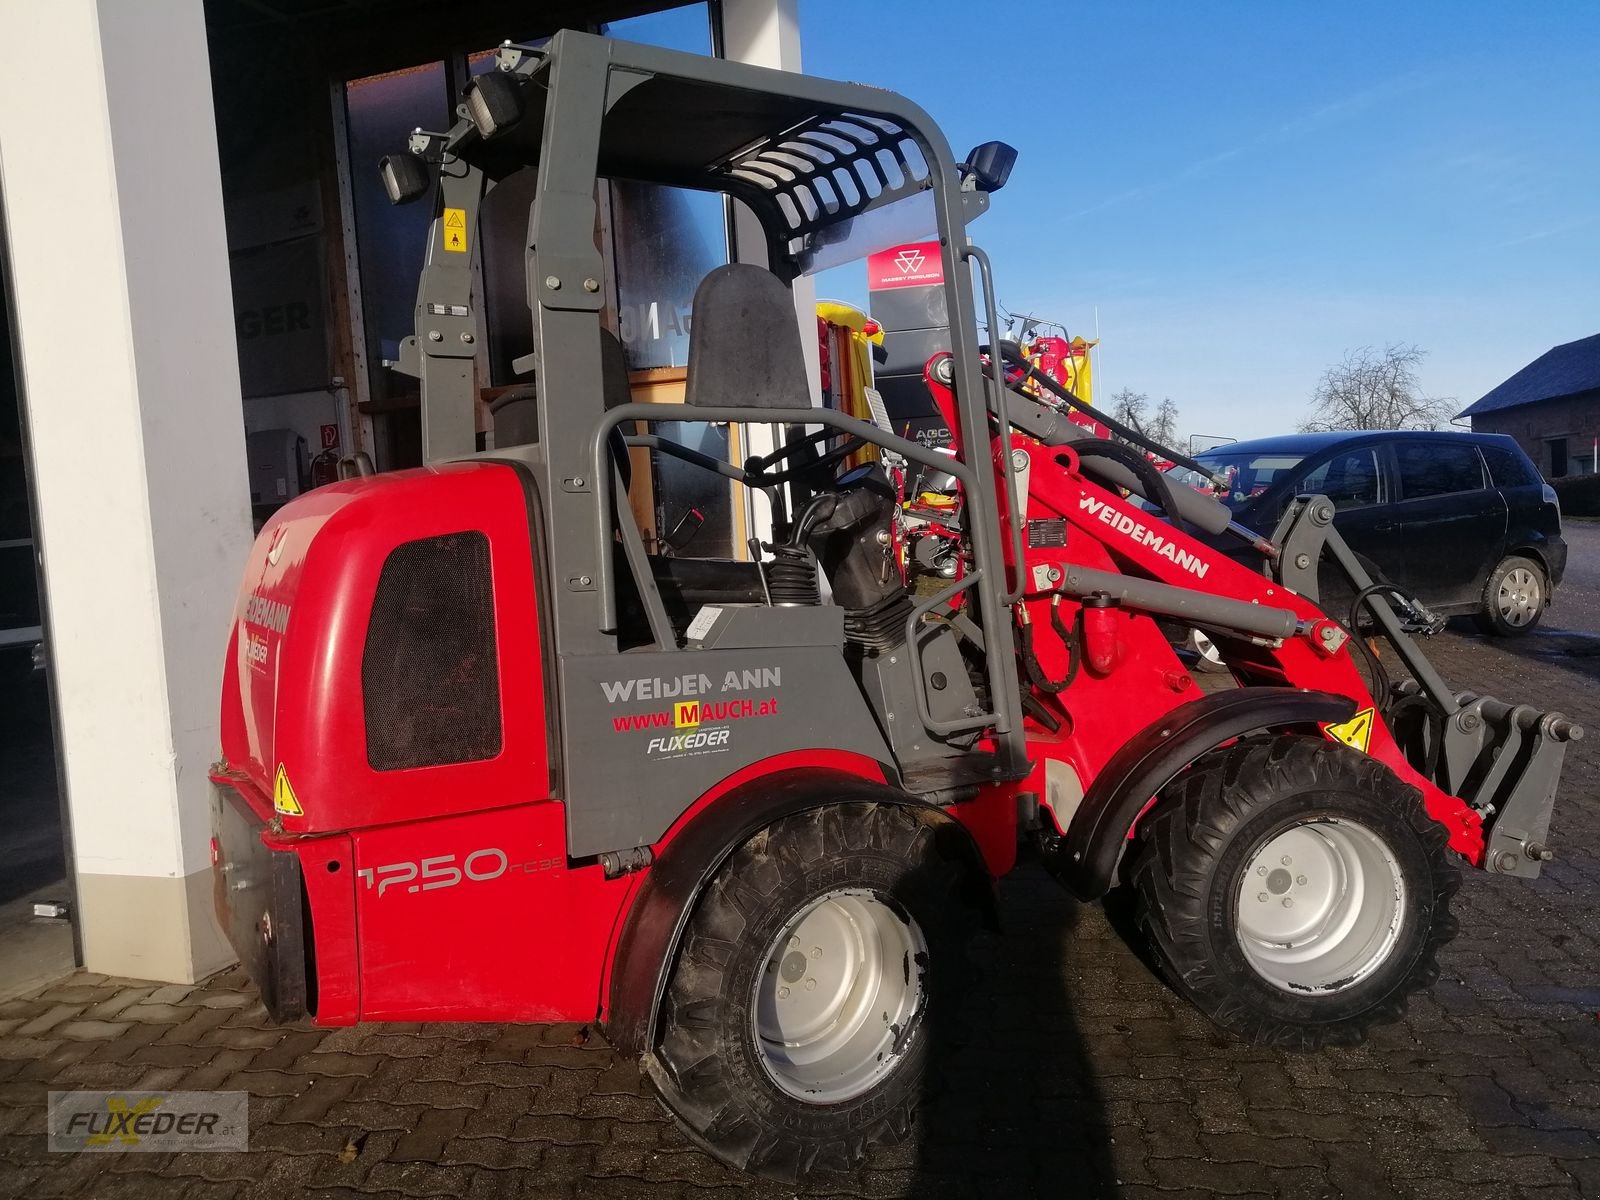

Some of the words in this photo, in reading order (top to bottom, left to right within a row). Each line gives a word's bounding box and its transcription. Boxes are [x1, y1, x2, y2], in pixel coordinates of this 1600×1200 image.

[915, 428, 952, 439] AGC
[1079, 490, 1210, 579] WEIDEMANN
[613, 697, 777, 733] www.MAUCH.at
[647, 730, 730, 754] FLIXEDER
